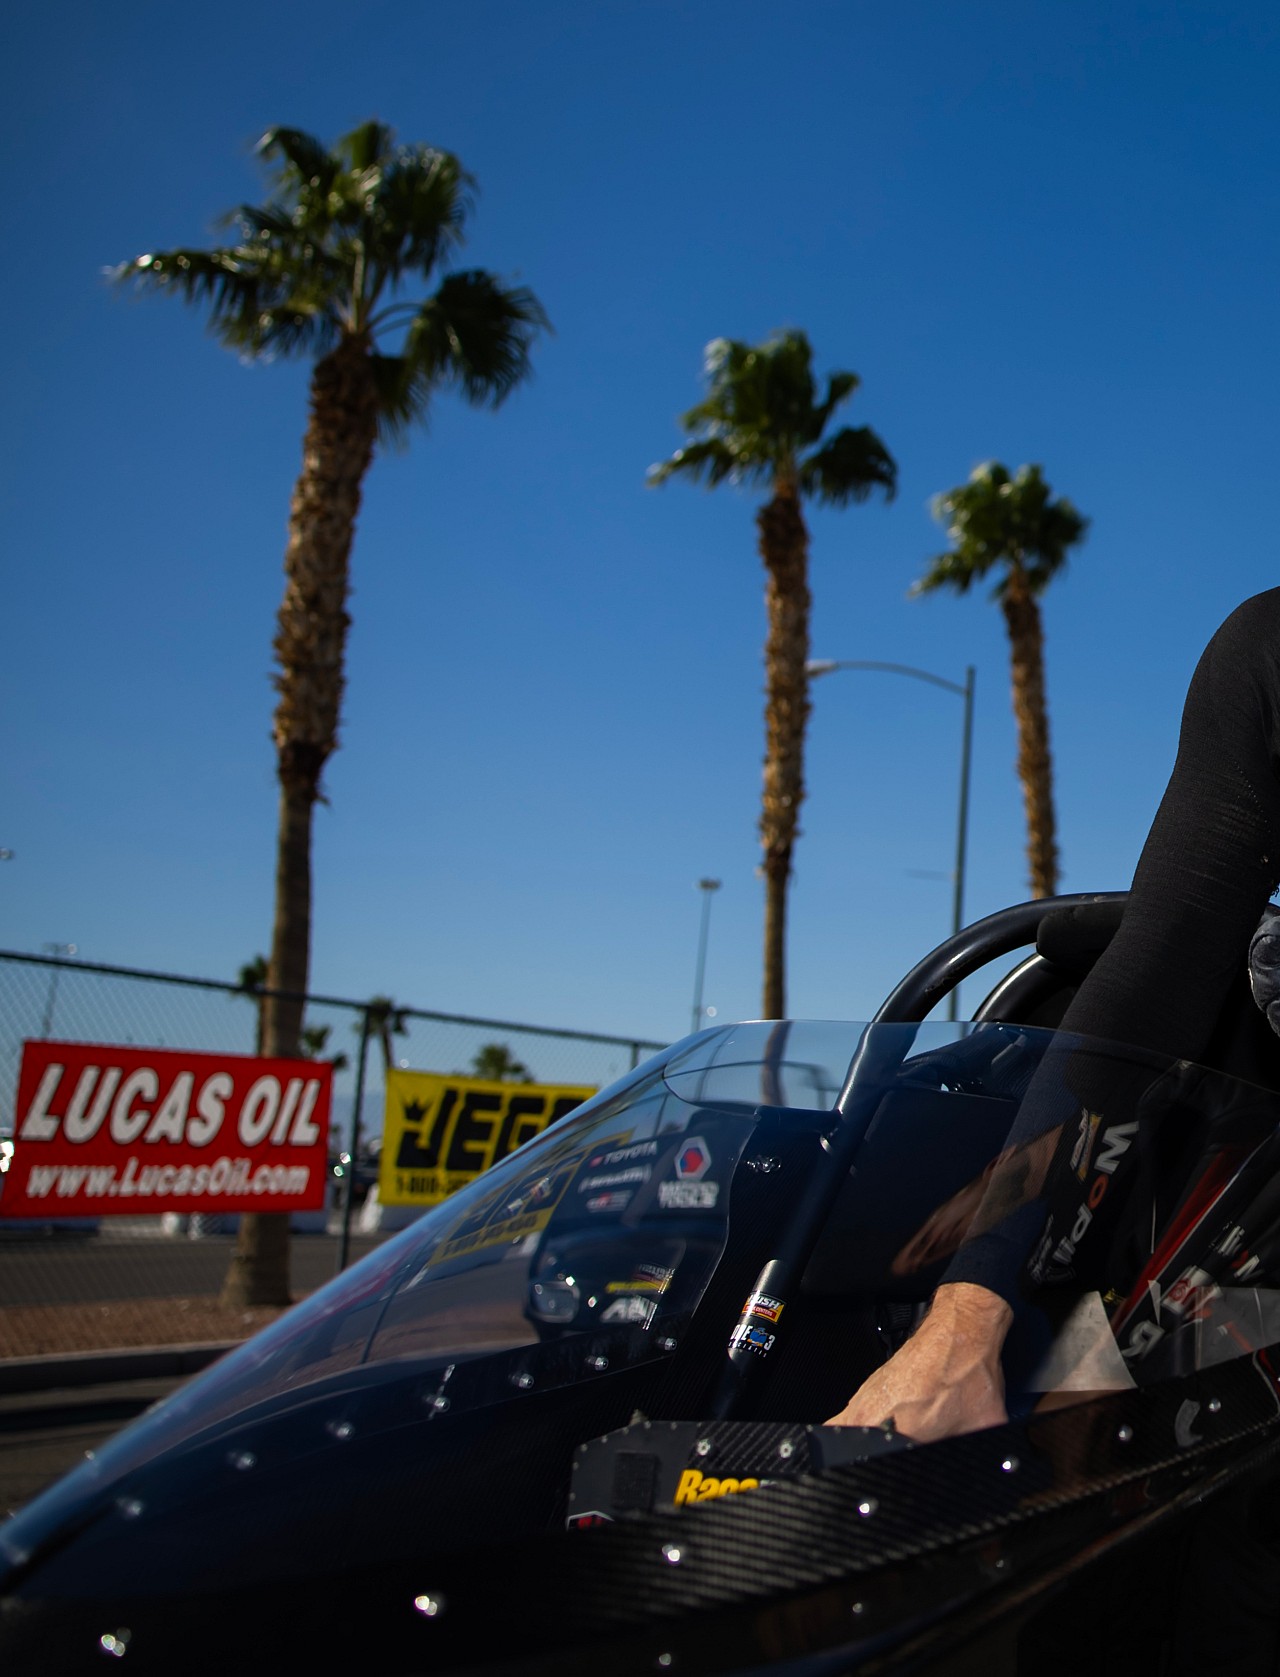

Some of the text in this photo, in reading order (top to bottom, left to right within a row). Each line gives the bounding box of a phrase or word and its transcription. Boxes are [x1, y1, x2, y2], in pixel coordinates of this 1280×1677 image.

[20, 1063, 321, 1147] LUCAS OIL
[26, 1156, 310, 1198] www.LucasOil.com
[763, 1334, 776, 1350] 3
